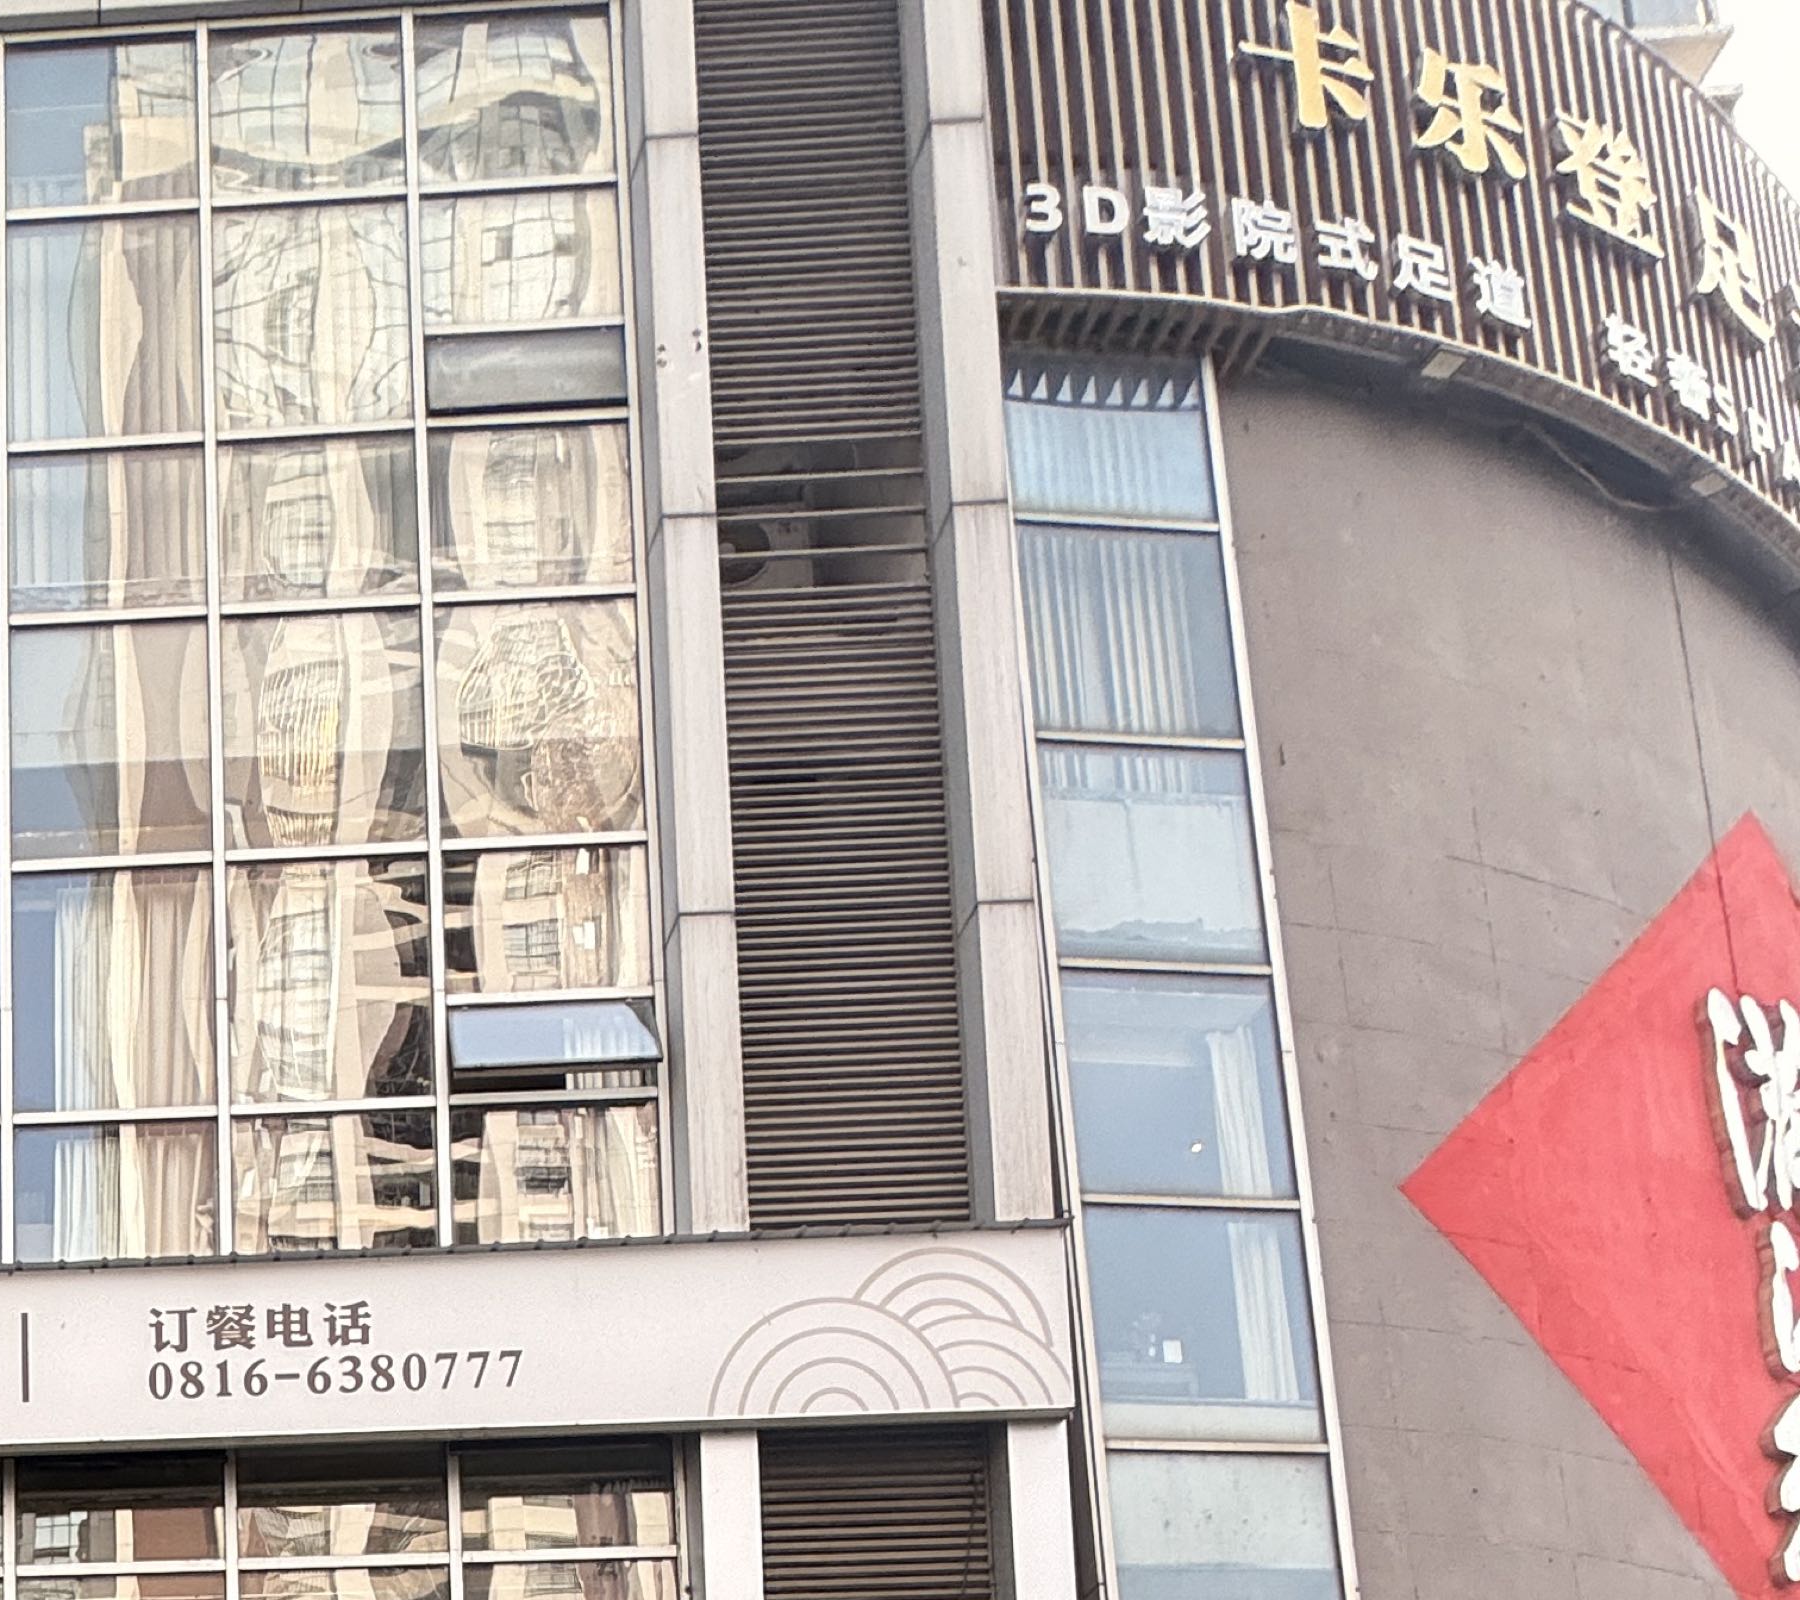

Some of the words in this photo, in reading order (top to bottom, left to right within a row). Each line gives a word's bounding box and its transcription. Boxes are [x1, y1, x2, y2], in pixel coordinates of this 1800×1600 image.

[1025, 184, 1533, 330] 3D影院式足道
[148, 1299, 373, 1354] 订餐电话
[147, 1348, 524, 1401] 0816-6380777
